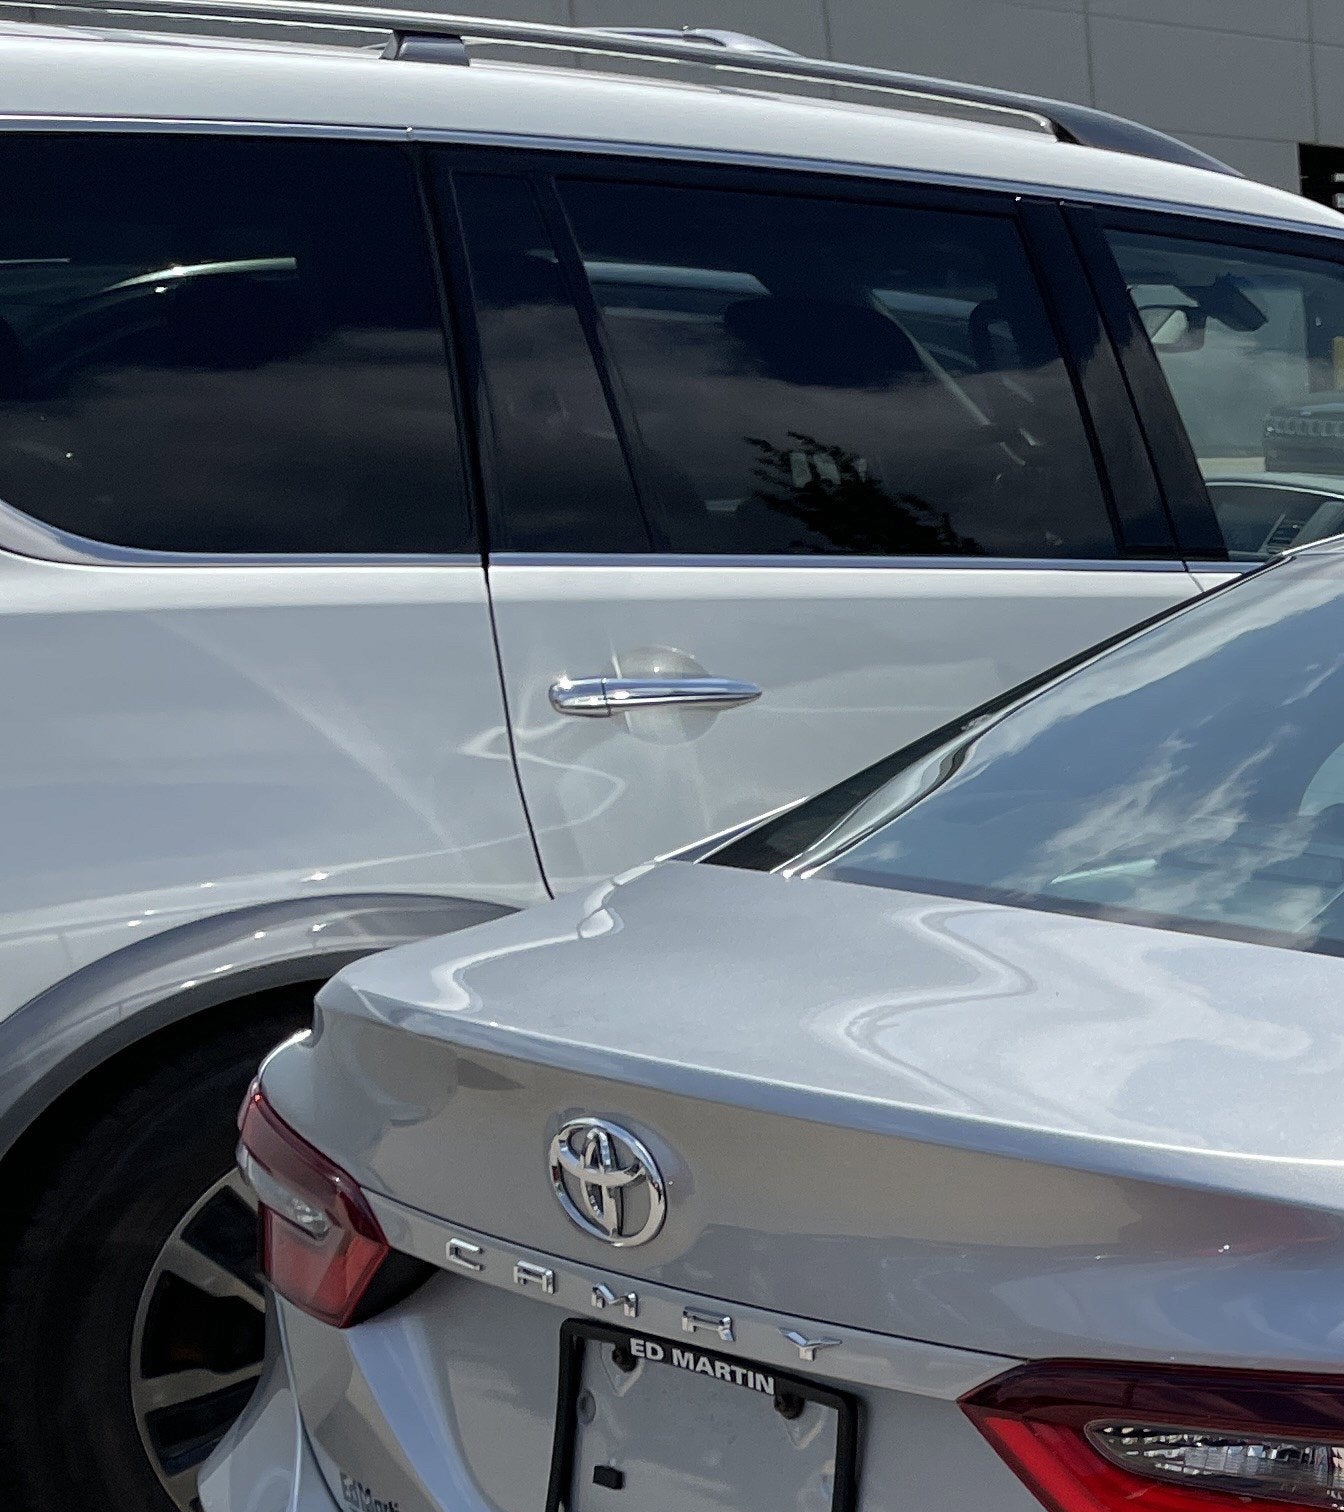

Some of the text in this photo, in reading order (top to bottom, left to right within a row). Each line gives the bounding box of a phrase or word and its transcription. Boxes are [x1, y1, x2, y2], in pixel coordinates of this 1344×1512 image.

[446, 1237, 842, 1361] CAMRY
[630, 1338, 775, 1396] ED MARTIN
